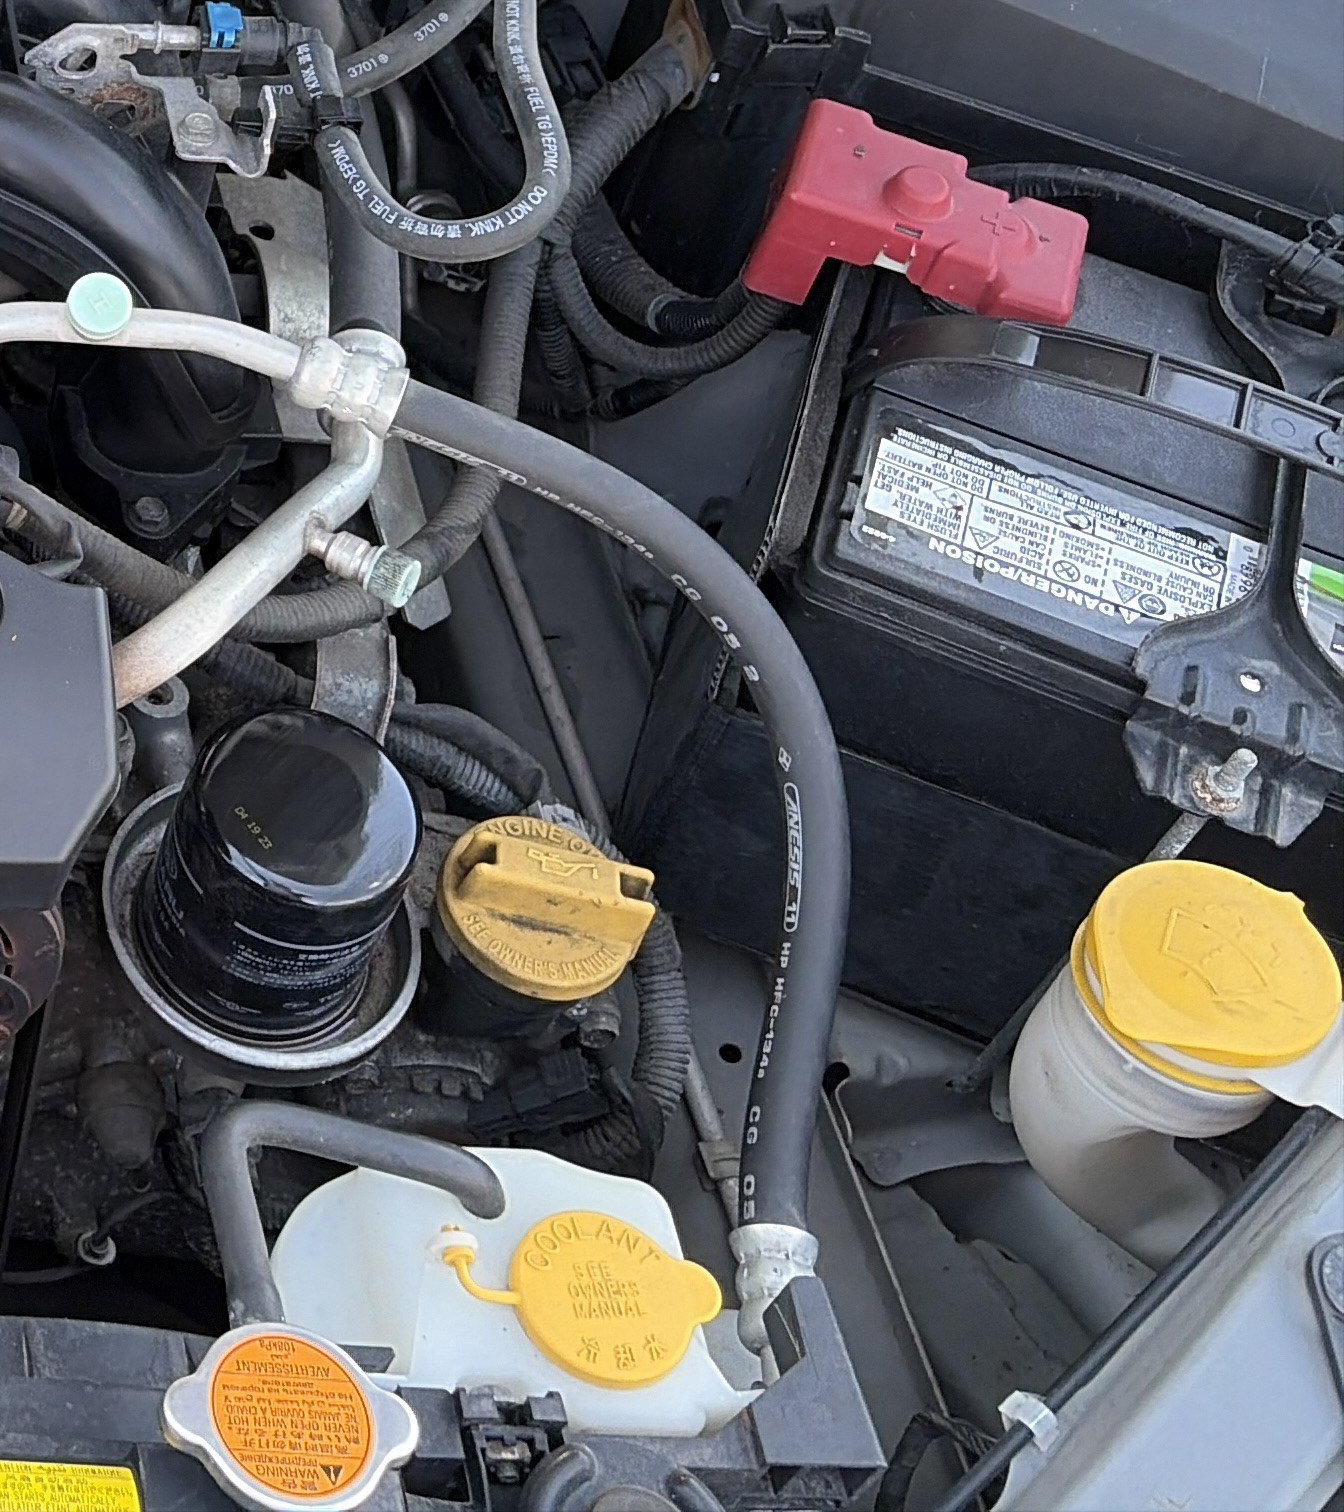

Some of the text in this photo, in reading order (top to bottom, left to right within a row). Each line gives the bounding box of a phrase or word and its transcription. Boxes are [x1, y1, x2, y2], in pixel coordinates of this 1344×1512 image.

[414, 18, 442, 42] 3701
[506, 0, 520, 19] NOT
[524, 87, 545, 111] FUEL
[347, 57, 379, 79] 3701
[527, 184, 547, 205] DO
[368, 195, 397, 225] FUEL
[508, 202, 534, 227] NOT
[951, 447, 993, 469] CHARGING
[874, 470, 920, 493] MEDICAL
[876, 461, 933, 489] HELP FAST.
[924, 465, 948, 479] OPEN
[949, 467, 969, 480] NOT
[950, 475, 968, 487] NOT
[970, 475, 984, 485] DO
[993, 463, 1025, 481] PROPER
[873, 479, 892, 492] GET
[969, 482, 983, 493] DO
[1024, 475, 1059, 494] FOLLOW
[891, 498, 961, 530] IMMEDIATELY
[935, 505, 963, 522] WITH
[1019, 500, 1035, 510] ALL
[1077, 495, 1114, 515] INVERTED
[897, 510, 959, 539] FLUSH EYES
[982, 513, 1048, 542] BLINDNESS OR
[1014, 515, 1050, 533] SEVERE
[1131, 516, 1196, 545] RECOMMENDED
[997, 528, 1046, 551] CAN CAUSE
[1114, 534, 1190, 565] KEEP OUT OF THE
[991, 545, 1043, 570] SULFURIC
[1018, 544, 1044, 560] ACID
[926, 536, 1116, 616] DANGER/POISON
[1082, 574, 1099, 586] NO
[1111, 558, 1214, 602] CAN CAUSE BLINDNESS
[1167, 570, 1216, 595] OR INJURY
[1118, 571, 1212, 612] EXPLOSIVE GASES
[258, 836, 272, 850] 23
[463, 914, 489, 942] SEE
[561, 948, 618, 980] MANUAL
[779, 941, 792, 969] HP
[524, 1217, 662, 1271] COOLANT
[573, 1261, 612, 1278] SEE
[572, 1300, 649, 1321] MANUAL
[258, 1338, 295, 1352] 108kPa
[234, 1359, 329, 1377] AVERTISSEMENT
[271, 1406, 304, 1418] OUVRIR
[308, 1409, 341, 1422] JAMAIS
[345, 1412, 356, 1423] NE
[253, 1417, 359, 1434] NEVER OPEN WHEN
[255, 1464, 319, 1479] WARNING
[19, 1492, 46, 1502] STARTS
[49, 1494, 117, 1507] AUTOMATICALLY
